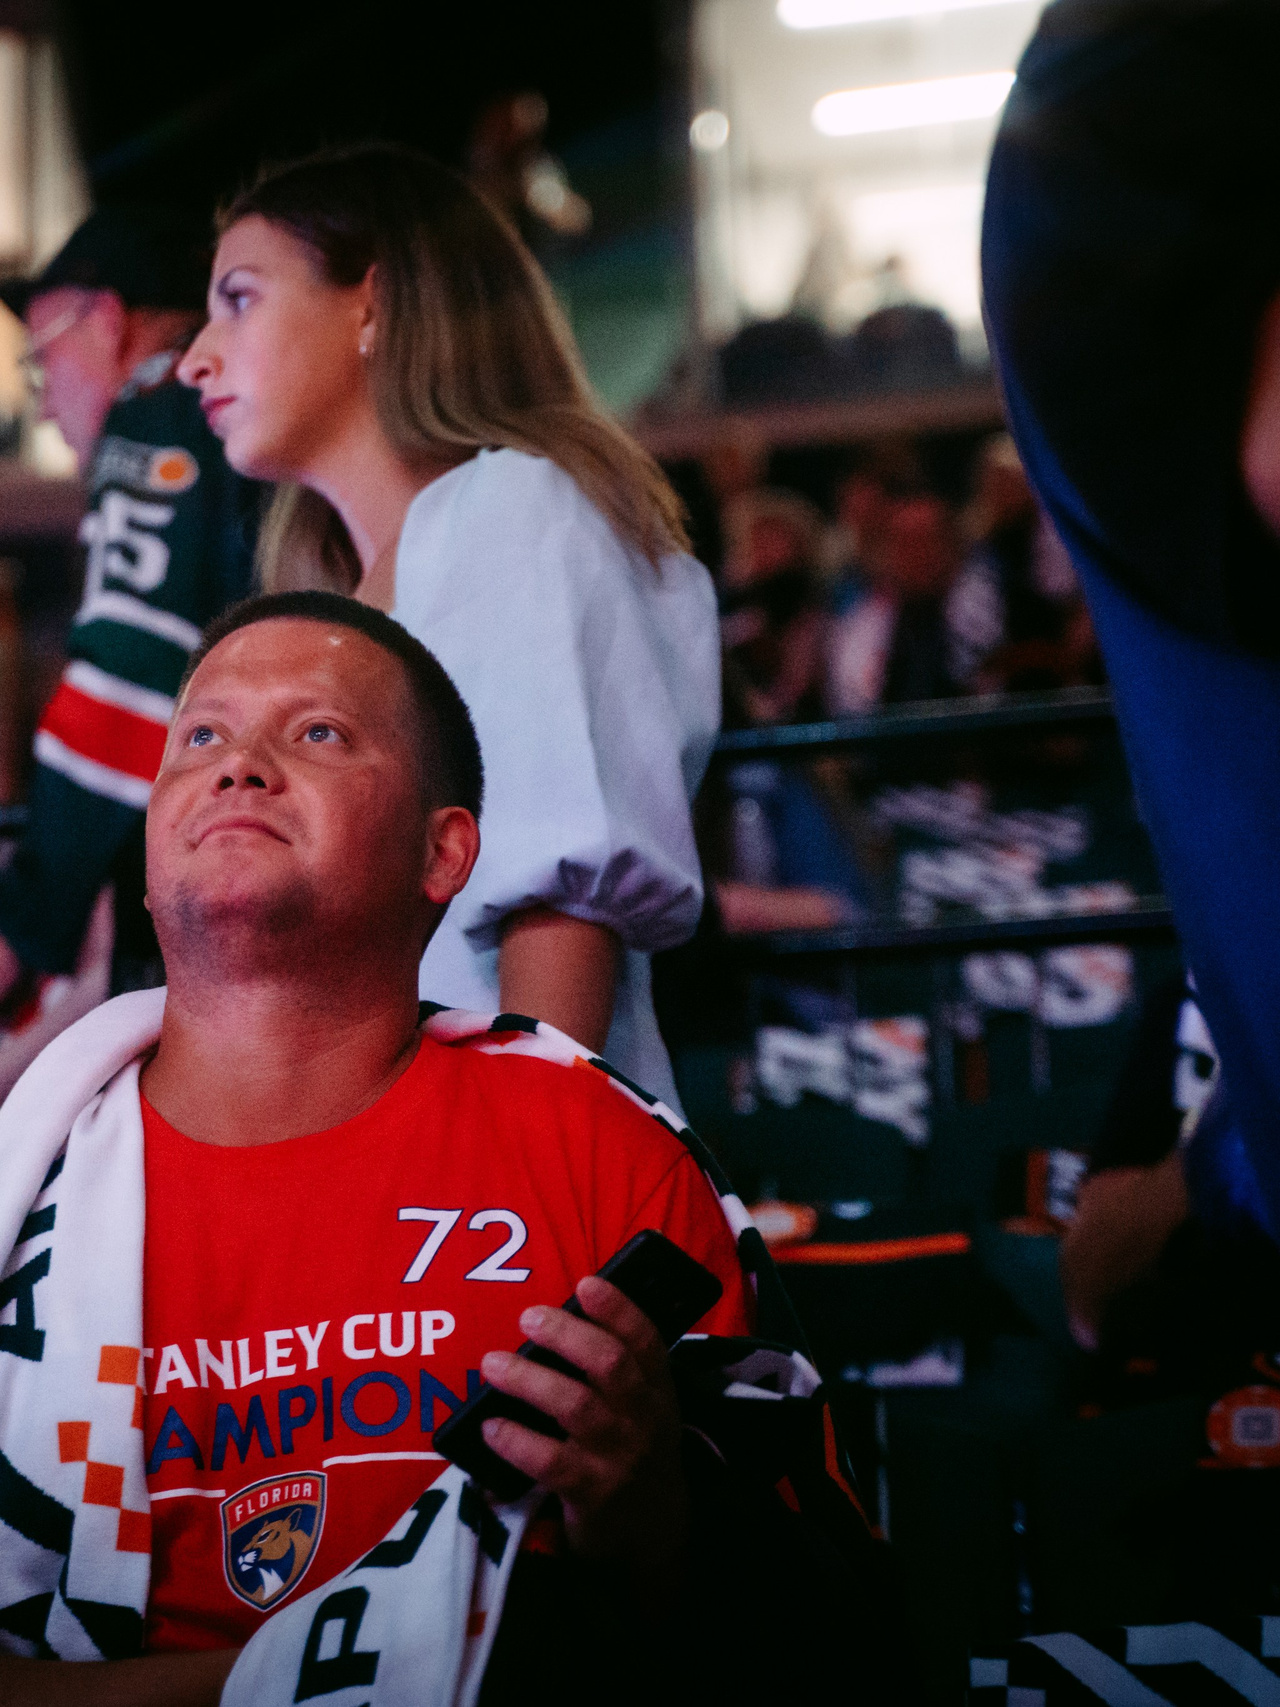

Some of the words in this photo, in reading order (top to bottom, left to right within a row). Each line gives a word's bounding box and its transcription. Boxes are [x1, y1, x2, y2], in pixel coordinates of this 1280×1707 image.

[397, 1206, 531, 1284] 72
[140, 1319, 331, 1395] TANLEY
[341, 1308, 456, 1361] CUP
[146, 1368, 482, 1476] AMPION
[234, 1481, 313, 1523] FLORIDA
